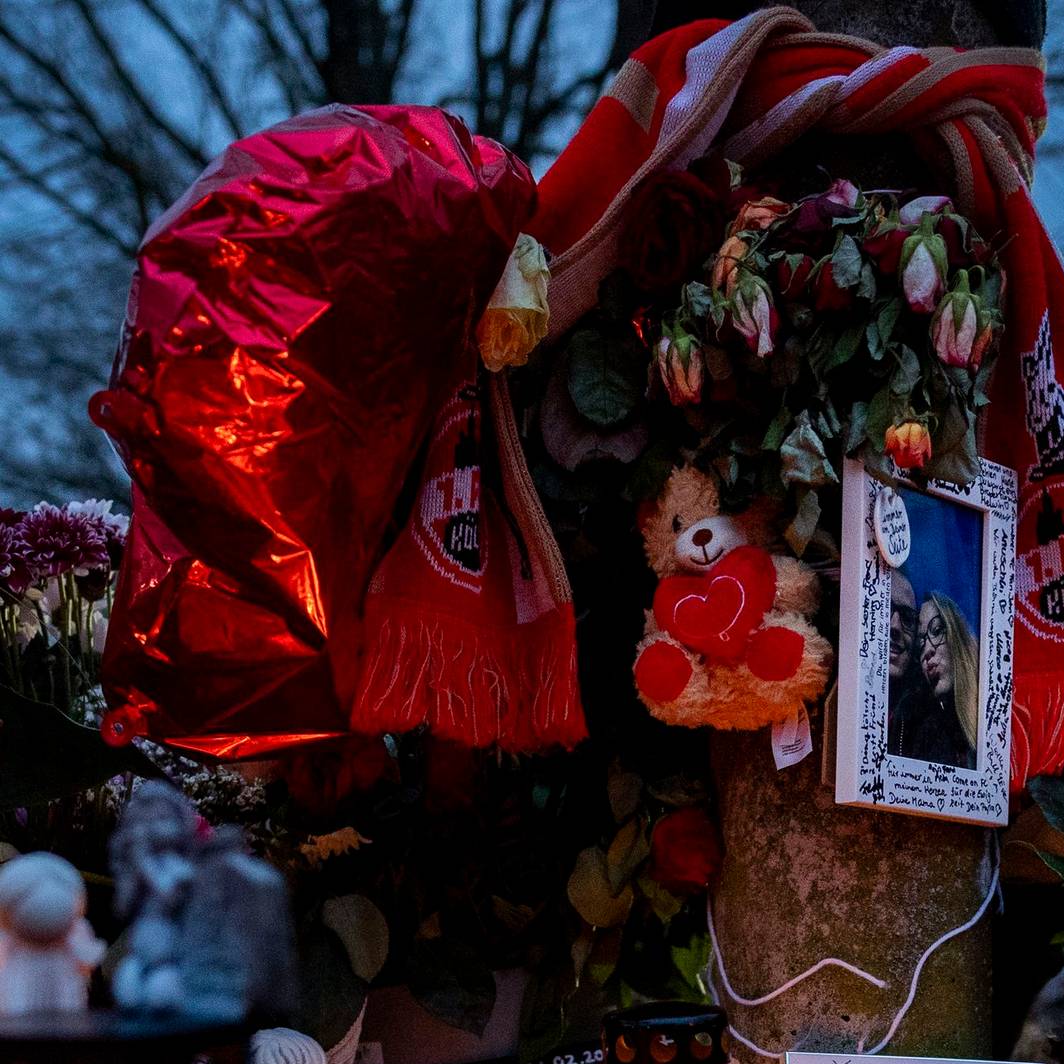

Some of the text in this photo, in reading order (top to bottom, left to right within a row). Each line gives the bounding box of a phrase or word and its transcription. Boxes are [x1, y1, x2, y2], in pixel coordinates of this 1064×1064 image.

[450, 514, 480, 552] KÖL
[888, 792, 911, 804] Deine
[964, 789, 976, 798] die
